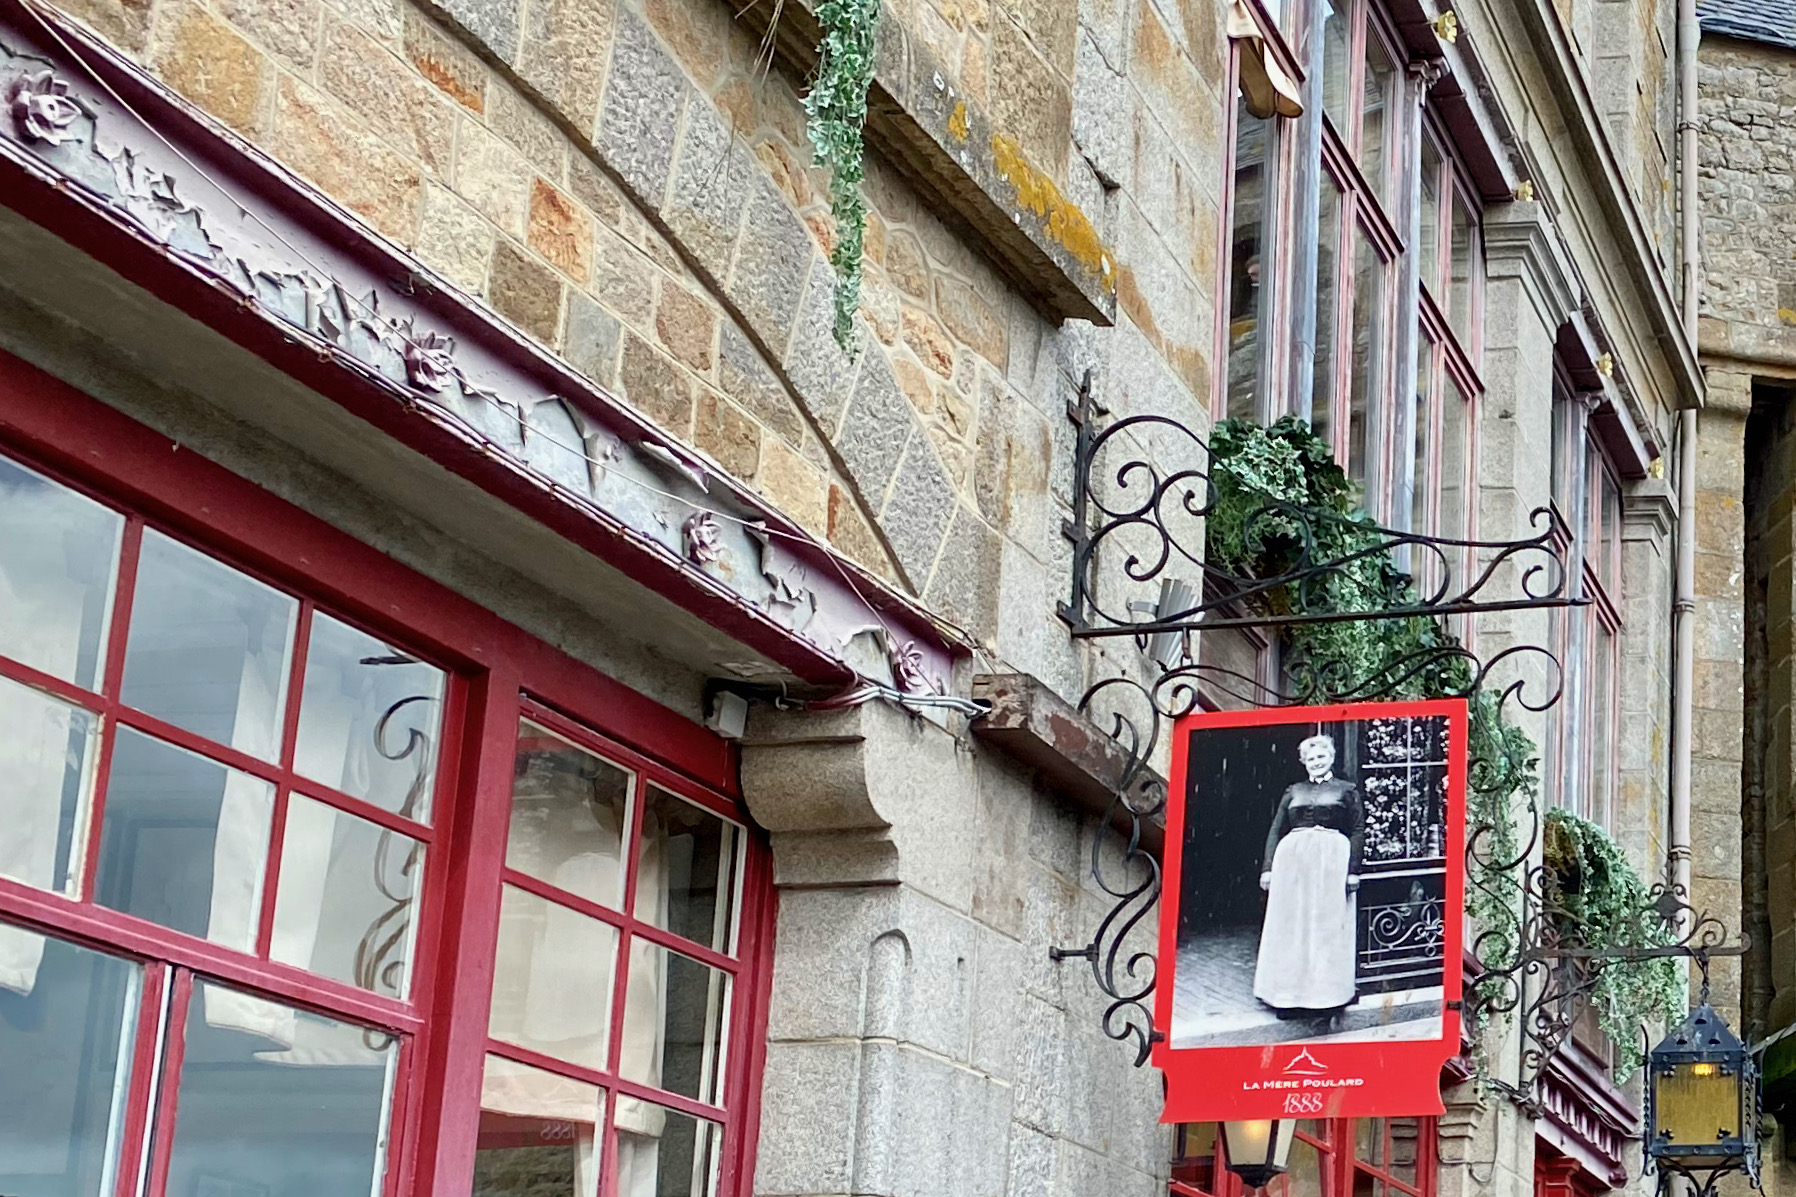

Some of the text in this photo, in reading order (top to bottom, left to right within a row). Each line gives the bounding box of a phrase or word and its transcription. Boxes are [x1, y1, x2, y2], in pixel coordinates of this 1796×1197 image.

[1243, 1082, 1260, 1090] LA
[1303, 1079, 1364, 1088] POULARD
[1282, 1092, 1323, 1113] 1888
